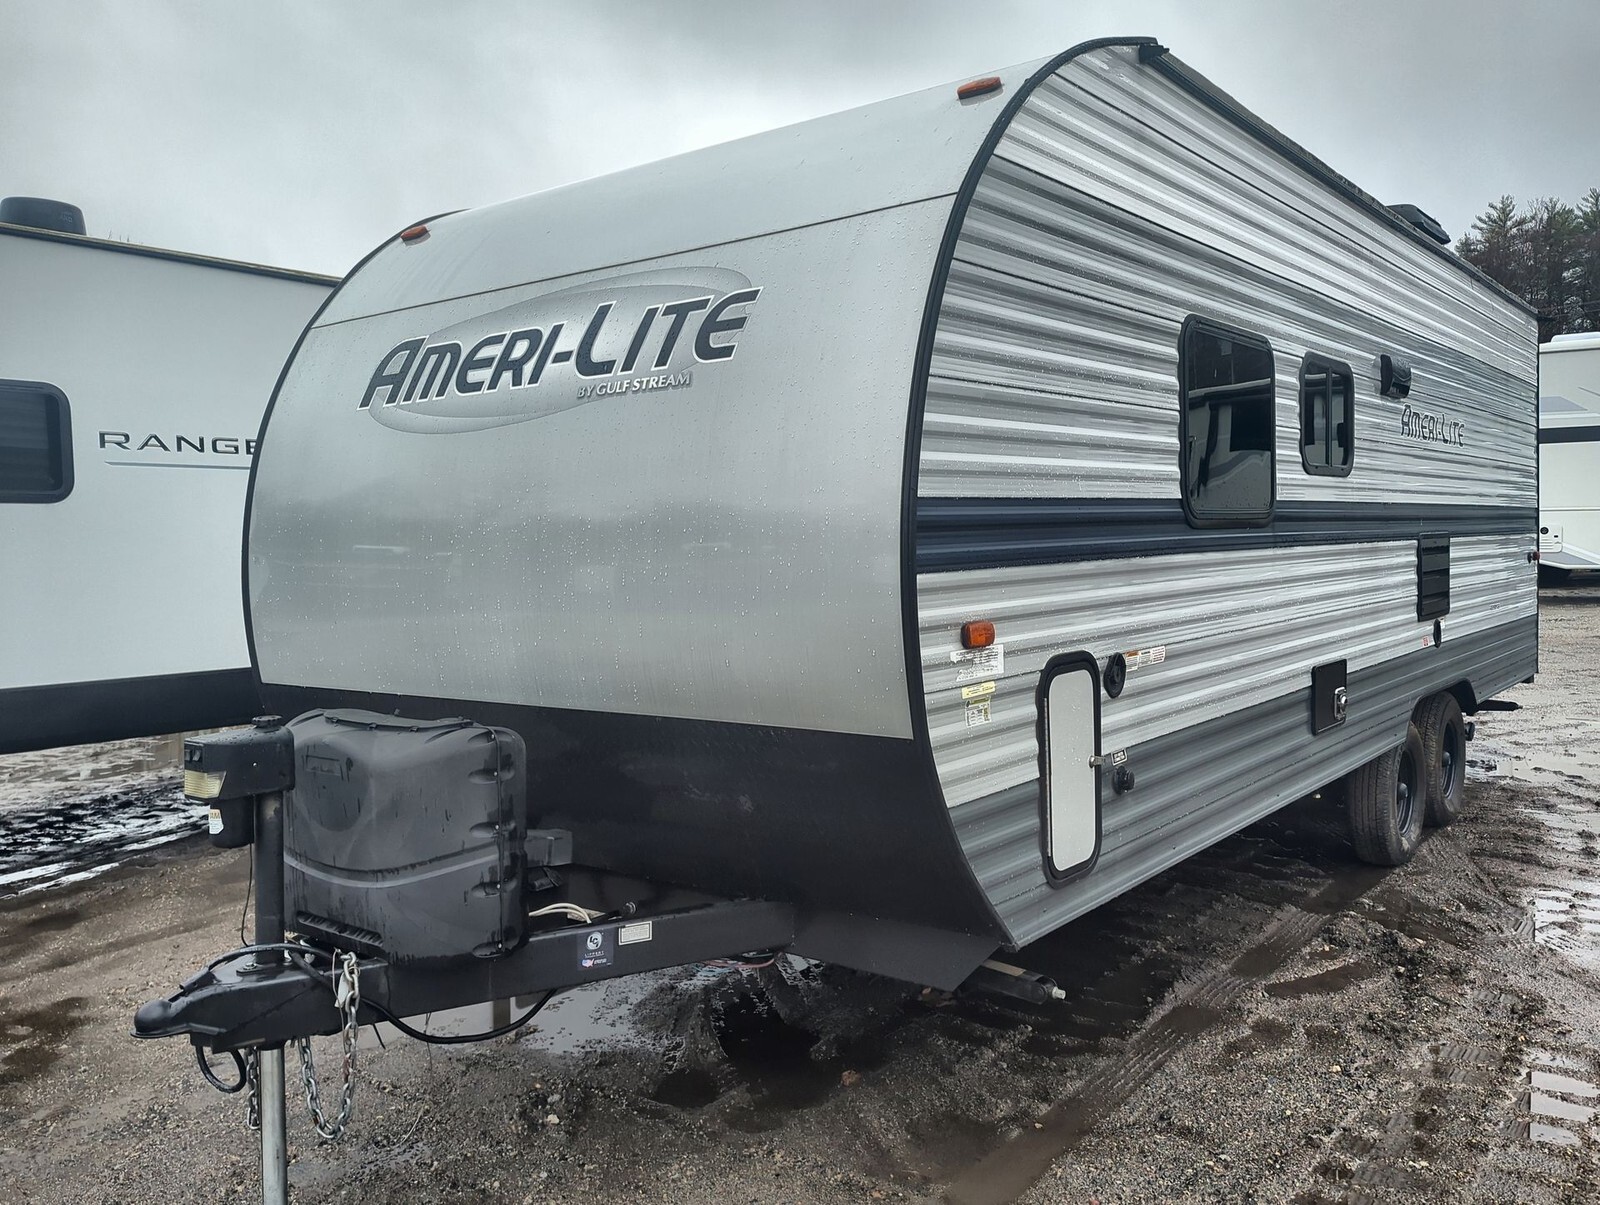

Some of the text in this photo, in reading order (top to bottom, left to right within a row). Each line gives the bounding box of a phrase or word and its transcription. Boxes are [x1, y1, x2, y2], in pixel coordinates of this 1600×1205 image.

[357, 286, 764, 411] AMERI-LITE
[577, 372, 693, 399] BY GULF STREAM
